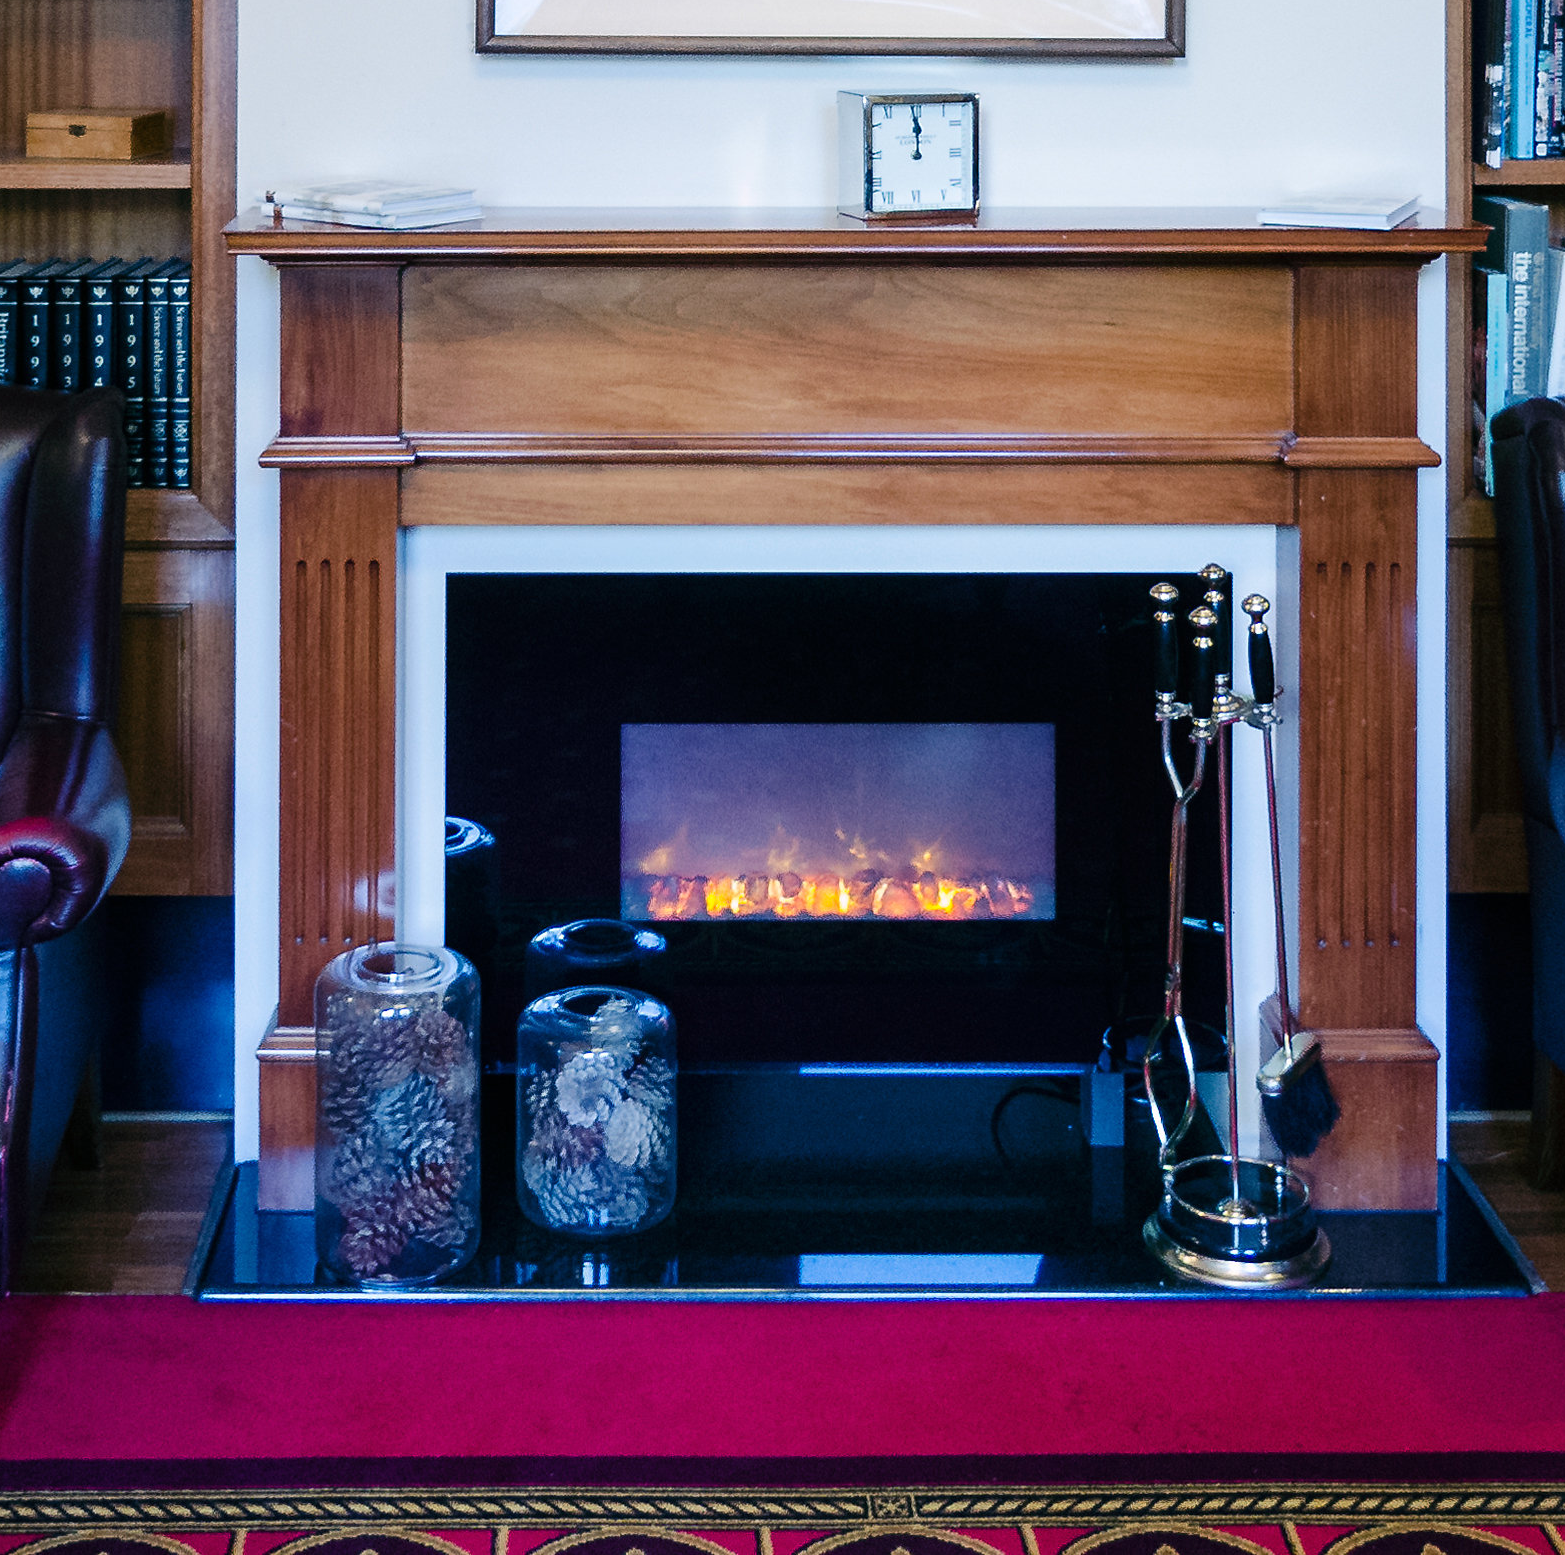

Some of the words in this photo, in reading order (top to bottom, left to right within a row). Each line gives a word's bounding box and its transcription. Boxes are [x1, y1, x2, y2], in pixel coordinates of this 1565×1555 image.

[883, 105, 893, 119] XI
[941, 105, 945, 117] I
[949, 148, 962, 158] III
[882, 191, 894, 204] VII
[911, 190, 921, 203] VI
[941, 189, 947, 201] V
[1512, 252, 1532, 282] the
[1512, 284, 1531, 395] international
